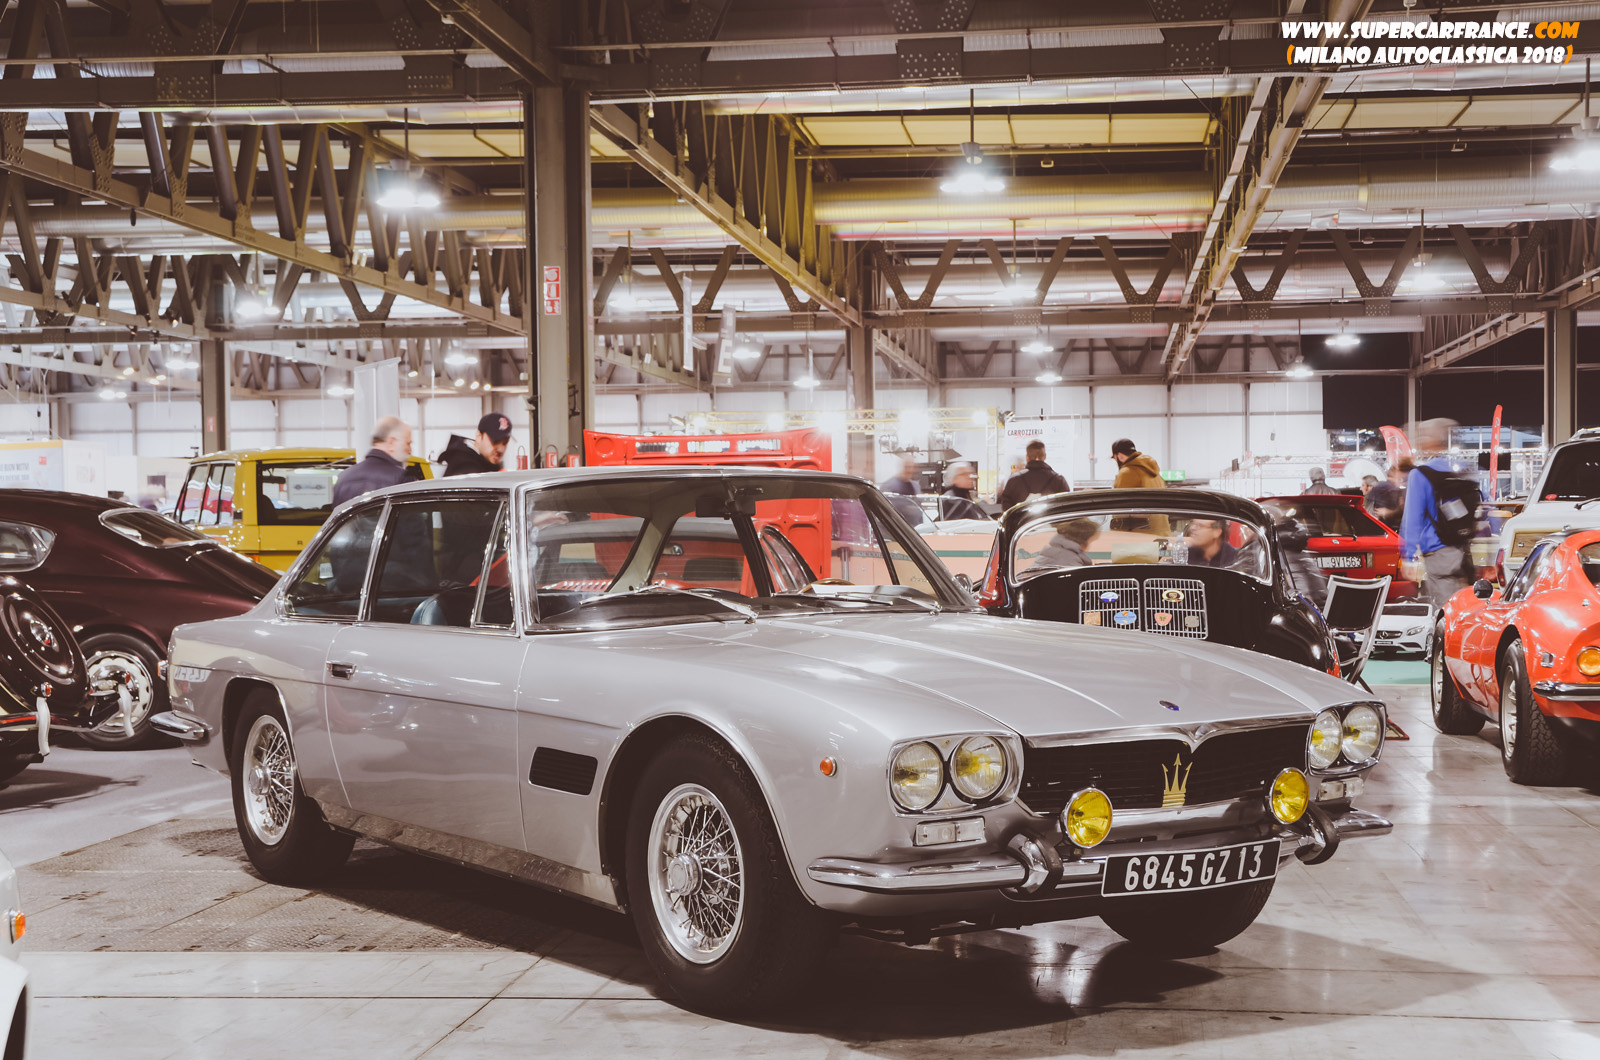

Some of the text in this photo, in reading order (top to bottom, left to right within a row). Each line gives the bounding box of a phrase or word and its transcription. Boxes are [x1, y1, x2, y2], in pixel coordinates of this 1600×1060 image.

[1124, 845, 1264, 891] 6845 GZ 13
